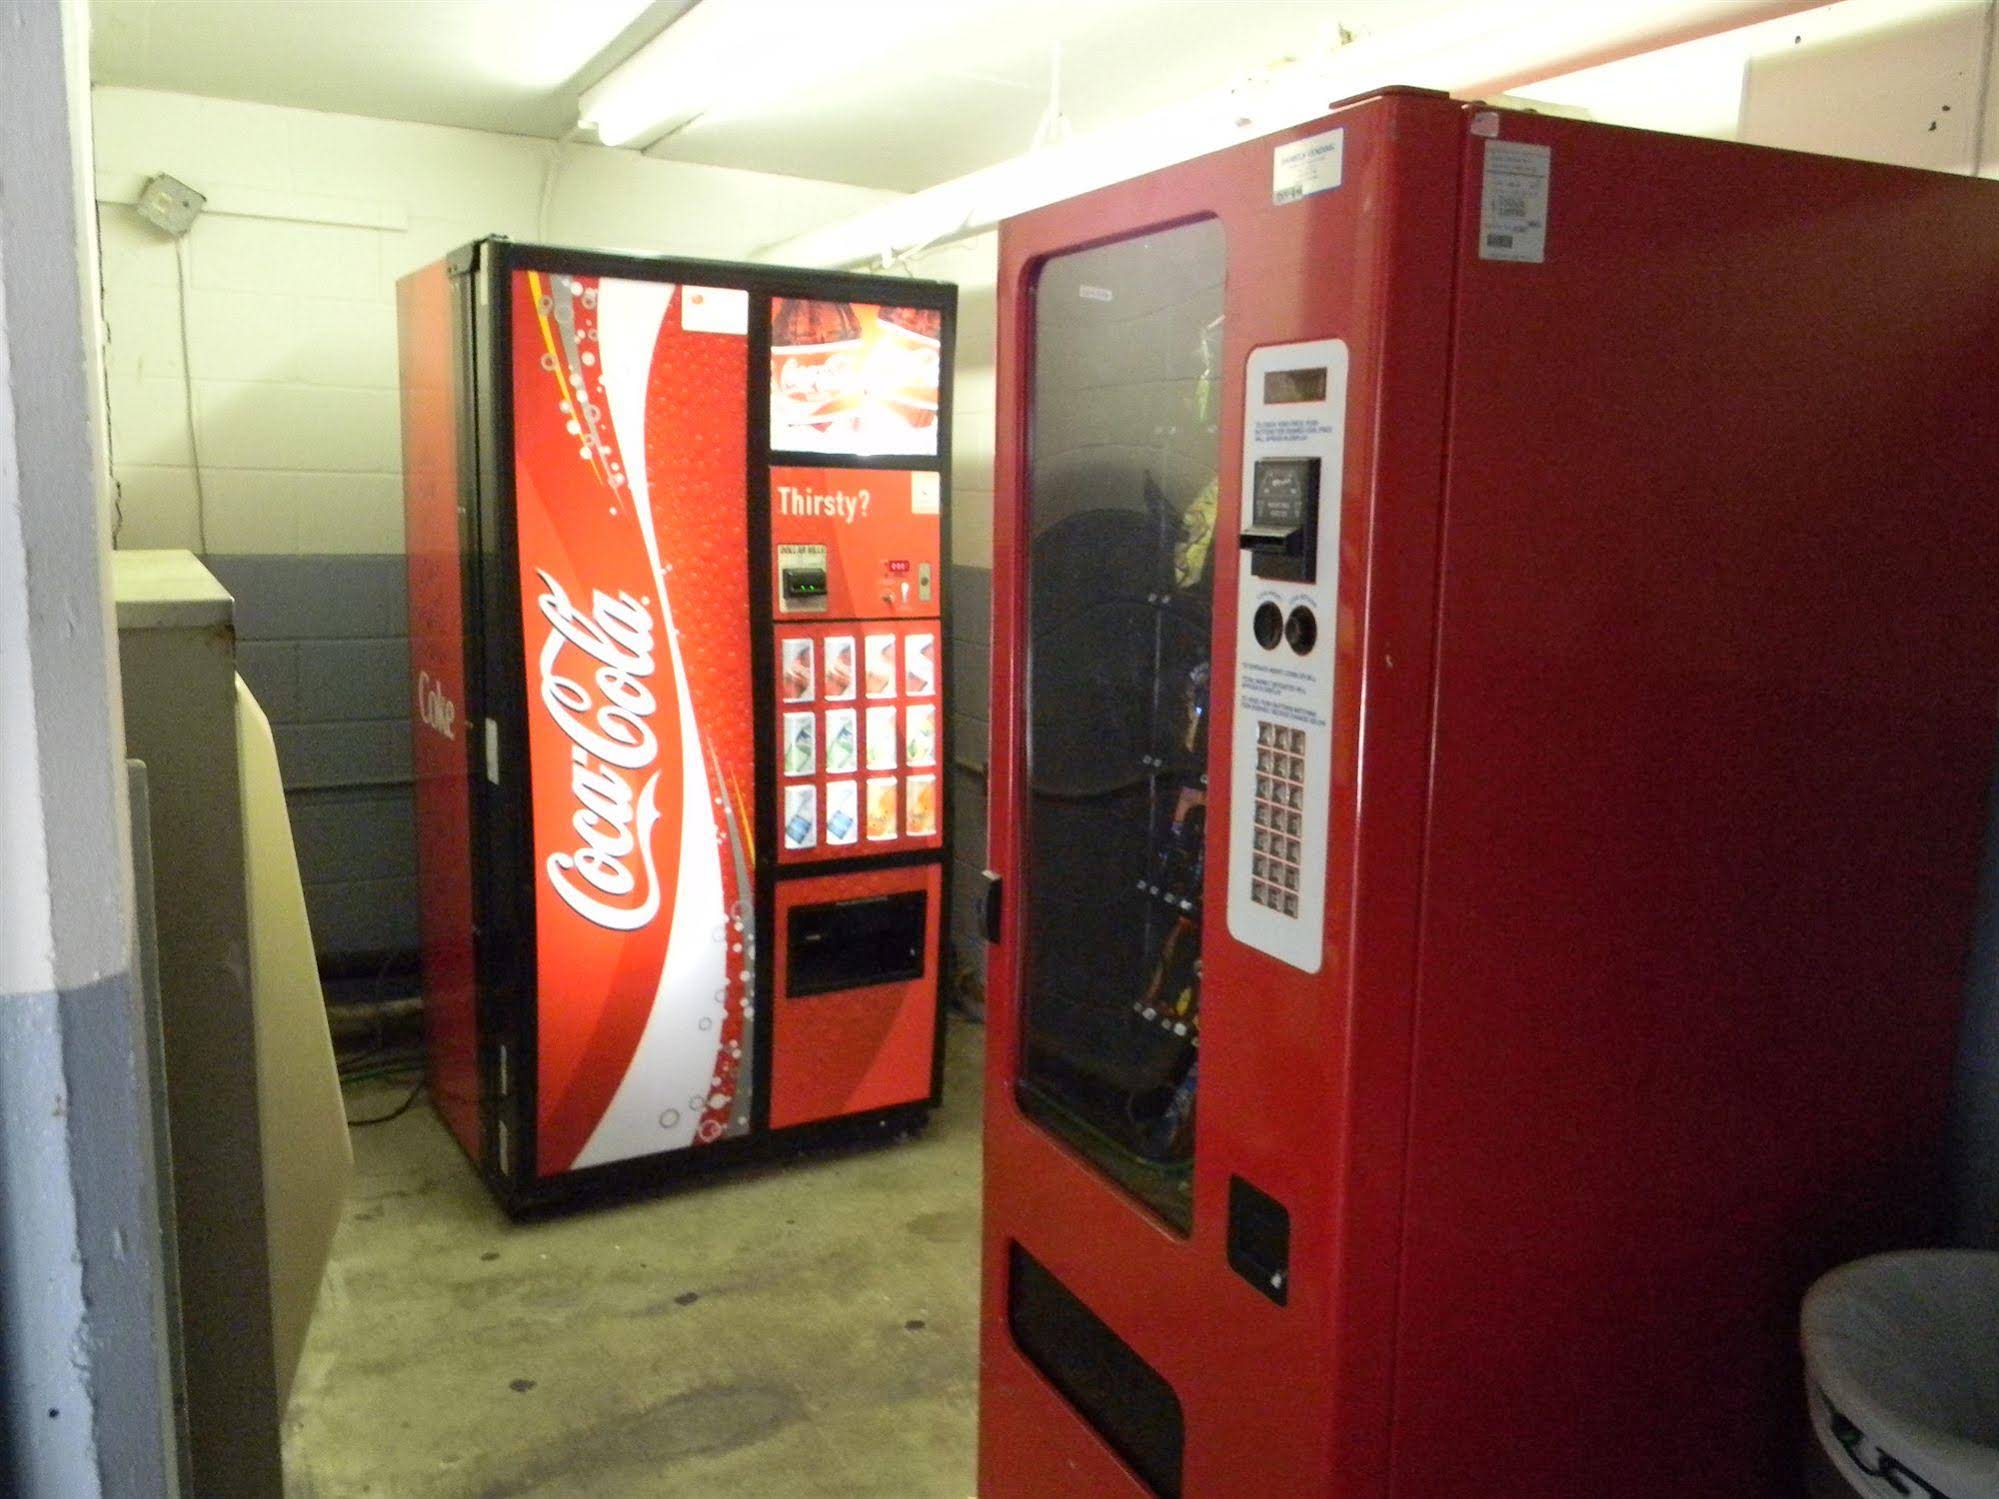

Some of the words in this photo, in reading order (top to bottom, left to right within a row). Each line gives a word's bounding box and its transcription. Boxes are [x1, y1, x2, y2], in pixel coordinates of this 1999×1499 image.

[777, 486, 870, 525] Thirsty?
[418, 671, 456, 741] Coke
[534, 567, 661, 931] Coca-Cola
